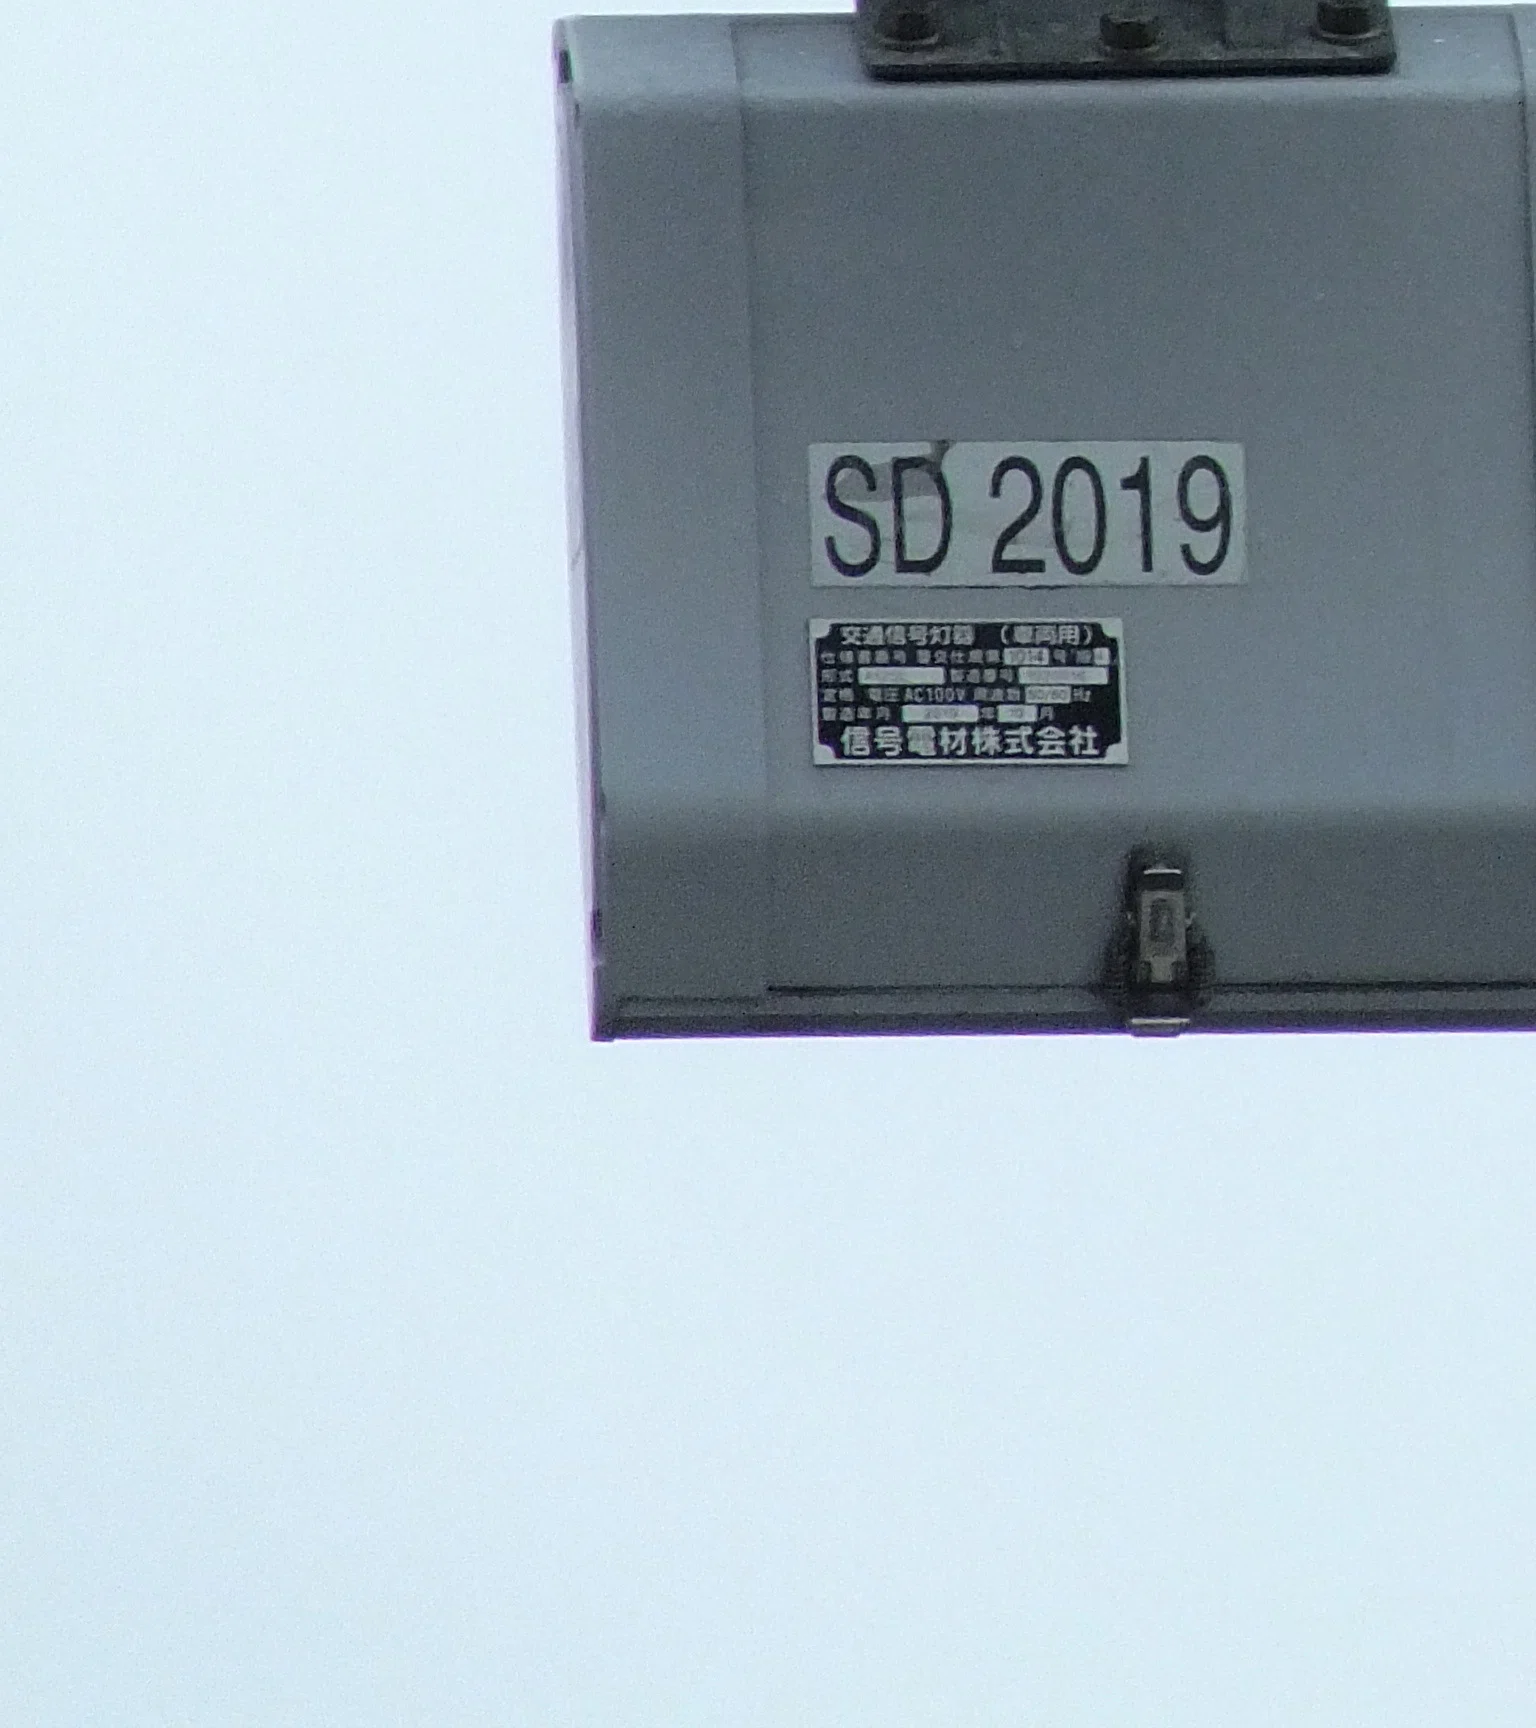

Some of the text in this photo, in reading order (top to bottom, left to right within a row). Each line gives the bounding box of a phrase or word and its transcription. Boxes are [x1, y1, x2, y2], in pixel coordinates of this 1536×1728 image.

[824, 455, 1232, 577] SD 2019
[840, 725, 1099, 757] 信号電材株式会社
